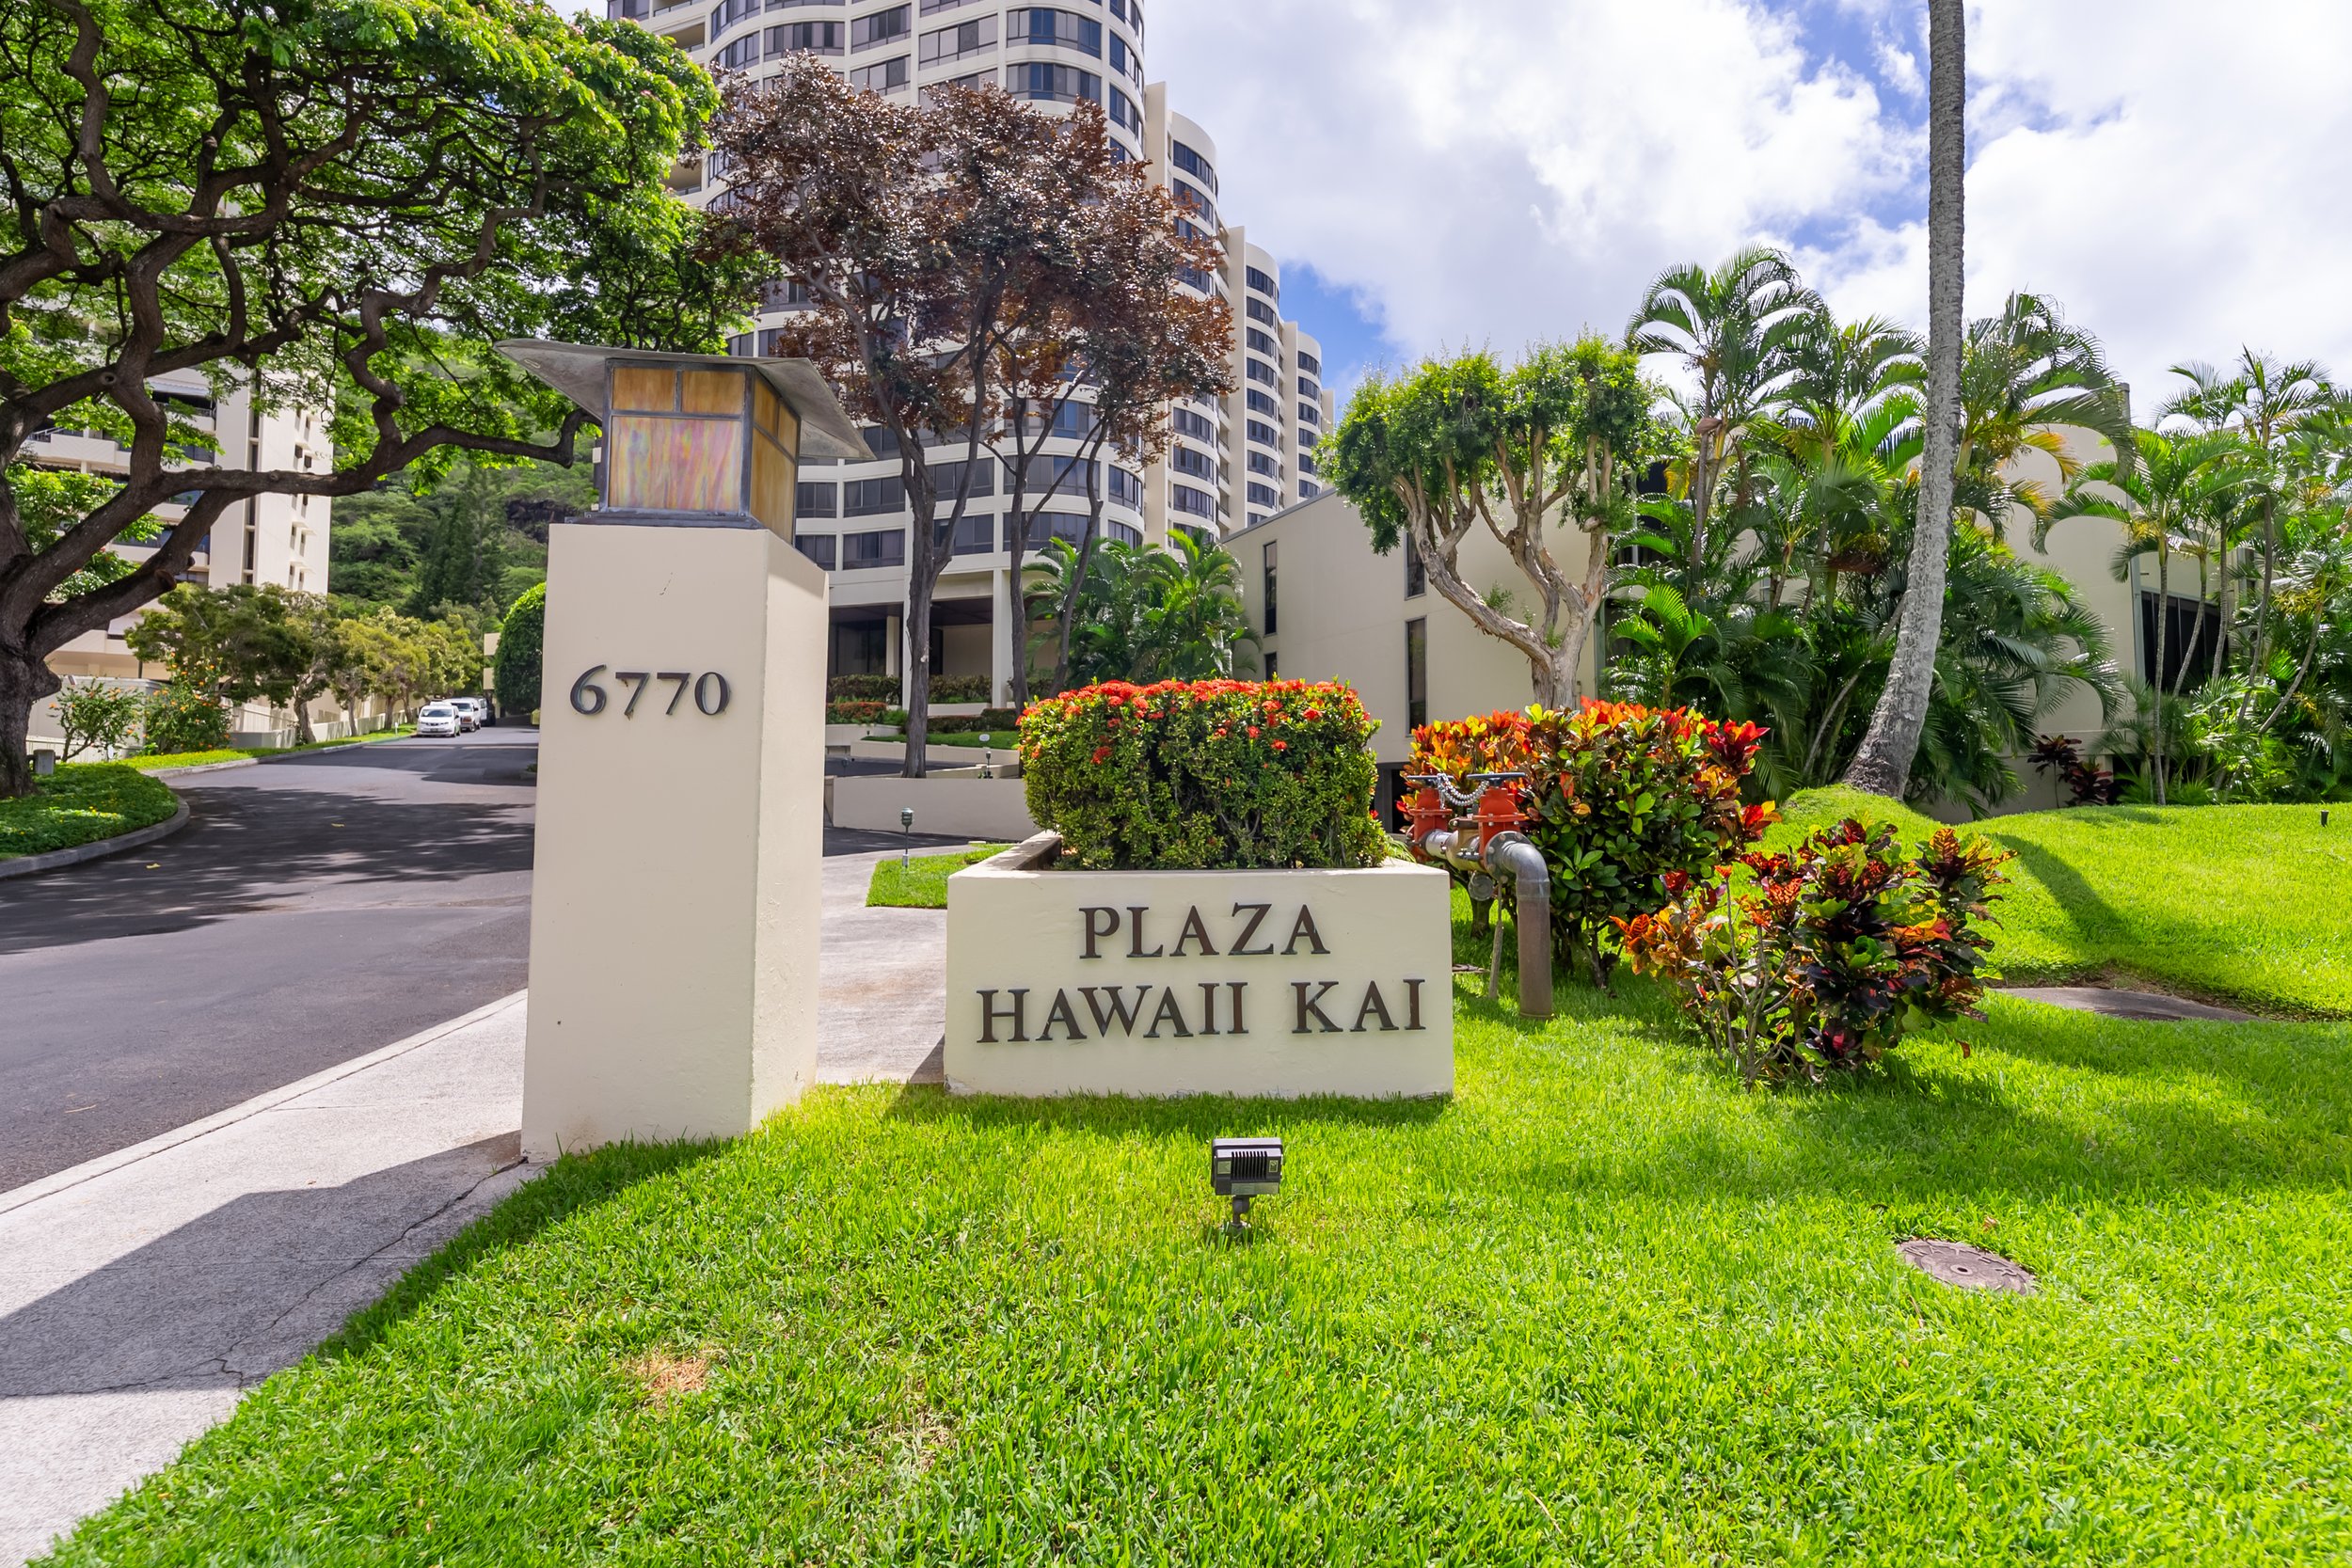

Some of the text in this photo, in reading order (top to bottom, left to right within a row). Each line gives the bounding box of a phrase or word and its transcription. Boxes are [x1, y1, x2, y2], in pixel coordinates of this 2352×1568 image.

[570, 664, 730, 715] 6770
[1079, 903, 1331, 959] PLAZA
[976, 979, 1426, 1043] HAWAII KAI
